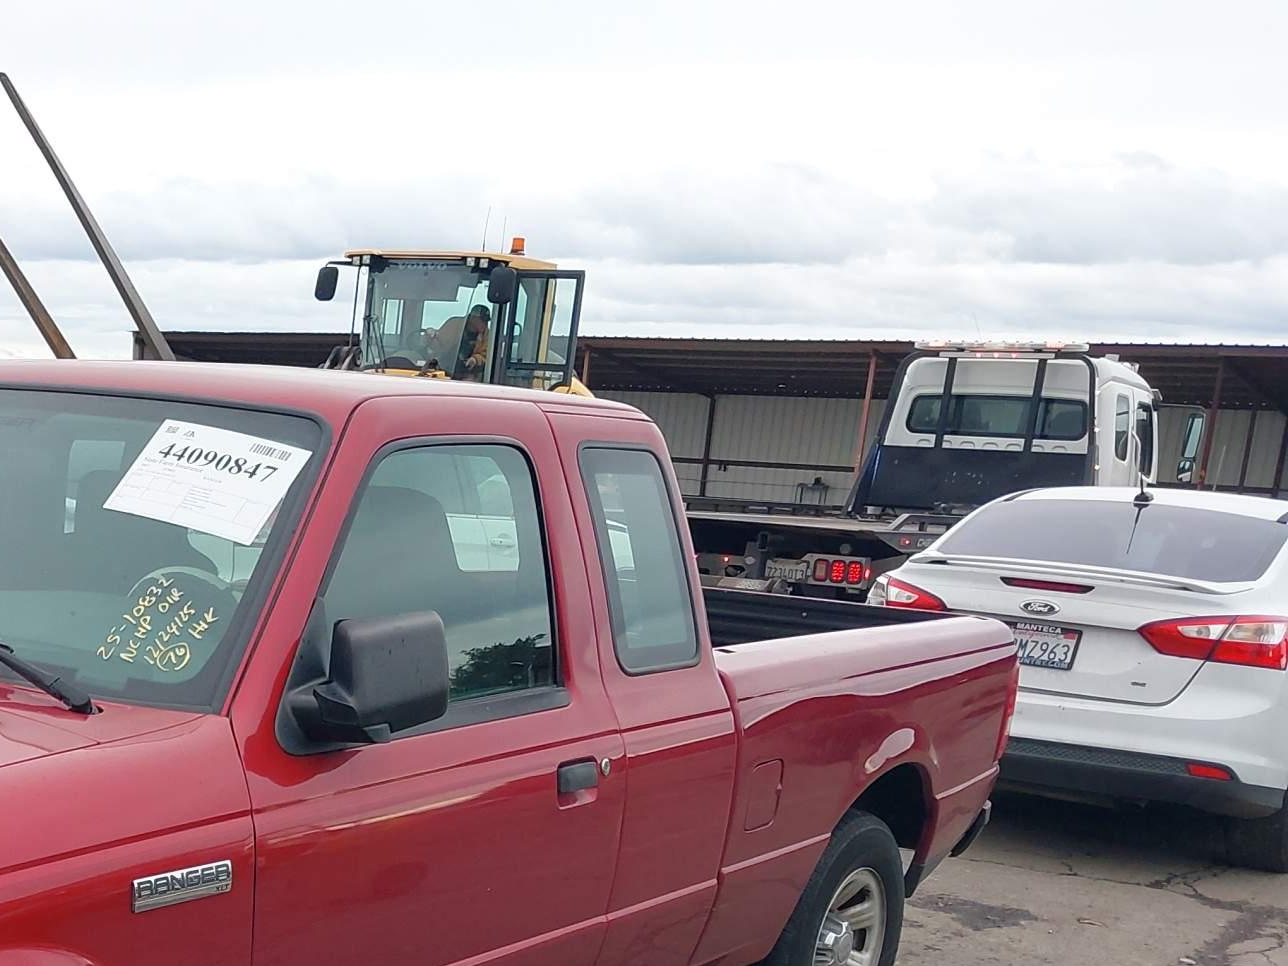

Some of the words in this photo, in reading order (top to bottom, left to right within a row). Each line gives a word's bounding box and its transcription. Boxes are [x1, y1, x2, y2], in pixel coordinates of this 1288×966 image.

[158, 442, 278, 482] 44090847
[97, 577, 174, 660] 25-10832
[1027, 602, 1052, 612] Ford
[1016, 622, 1062, 634] MANTECA
[136, 863, 231, 898] RANGER
